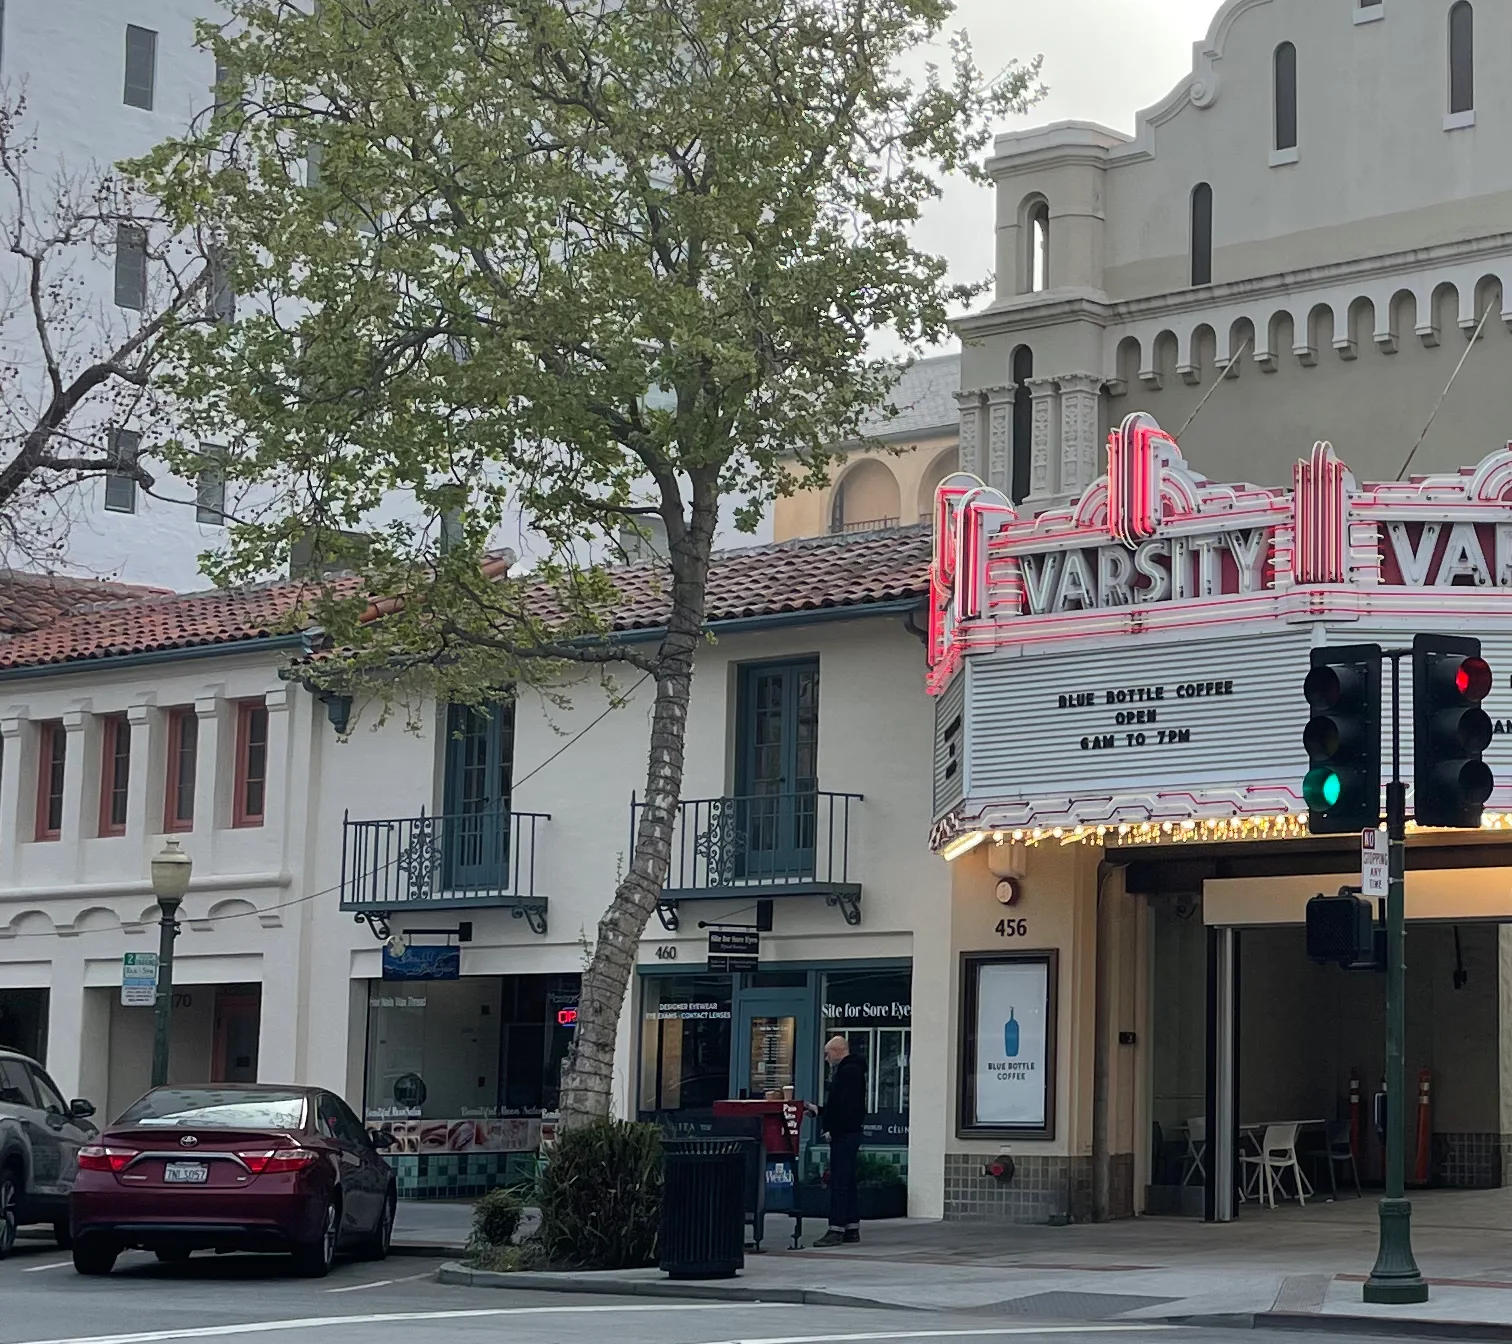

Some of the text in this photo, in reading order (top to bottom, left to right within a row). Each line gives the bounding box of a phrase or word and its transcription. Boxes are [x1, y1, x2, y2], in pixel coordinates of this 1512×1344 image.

[1020, 527, 1269, 616] VARSITY
[1058, 680, 1234, 708] BLUE BOTTLE COFFEE
[1115, 709, 1157, 726] OPEN
[1080, 729, 1191, 751] 6AM TO 7PM
[1364, 831, 1374, 847] NO
[995, 918, 1028, 937] 456
[127, 954, 134, 965] 2
[656, 945, 677, 959] 460
[174, 993, 192, 1008] 70
[558, 1010, 577, 1024] OP
[822, 1002, 912, 1019] Site for Sore Eye
[988, 1062, 1035, 1071] BLUE BOTTLE
[997, 1072, 1026, 1081] COFFEE
